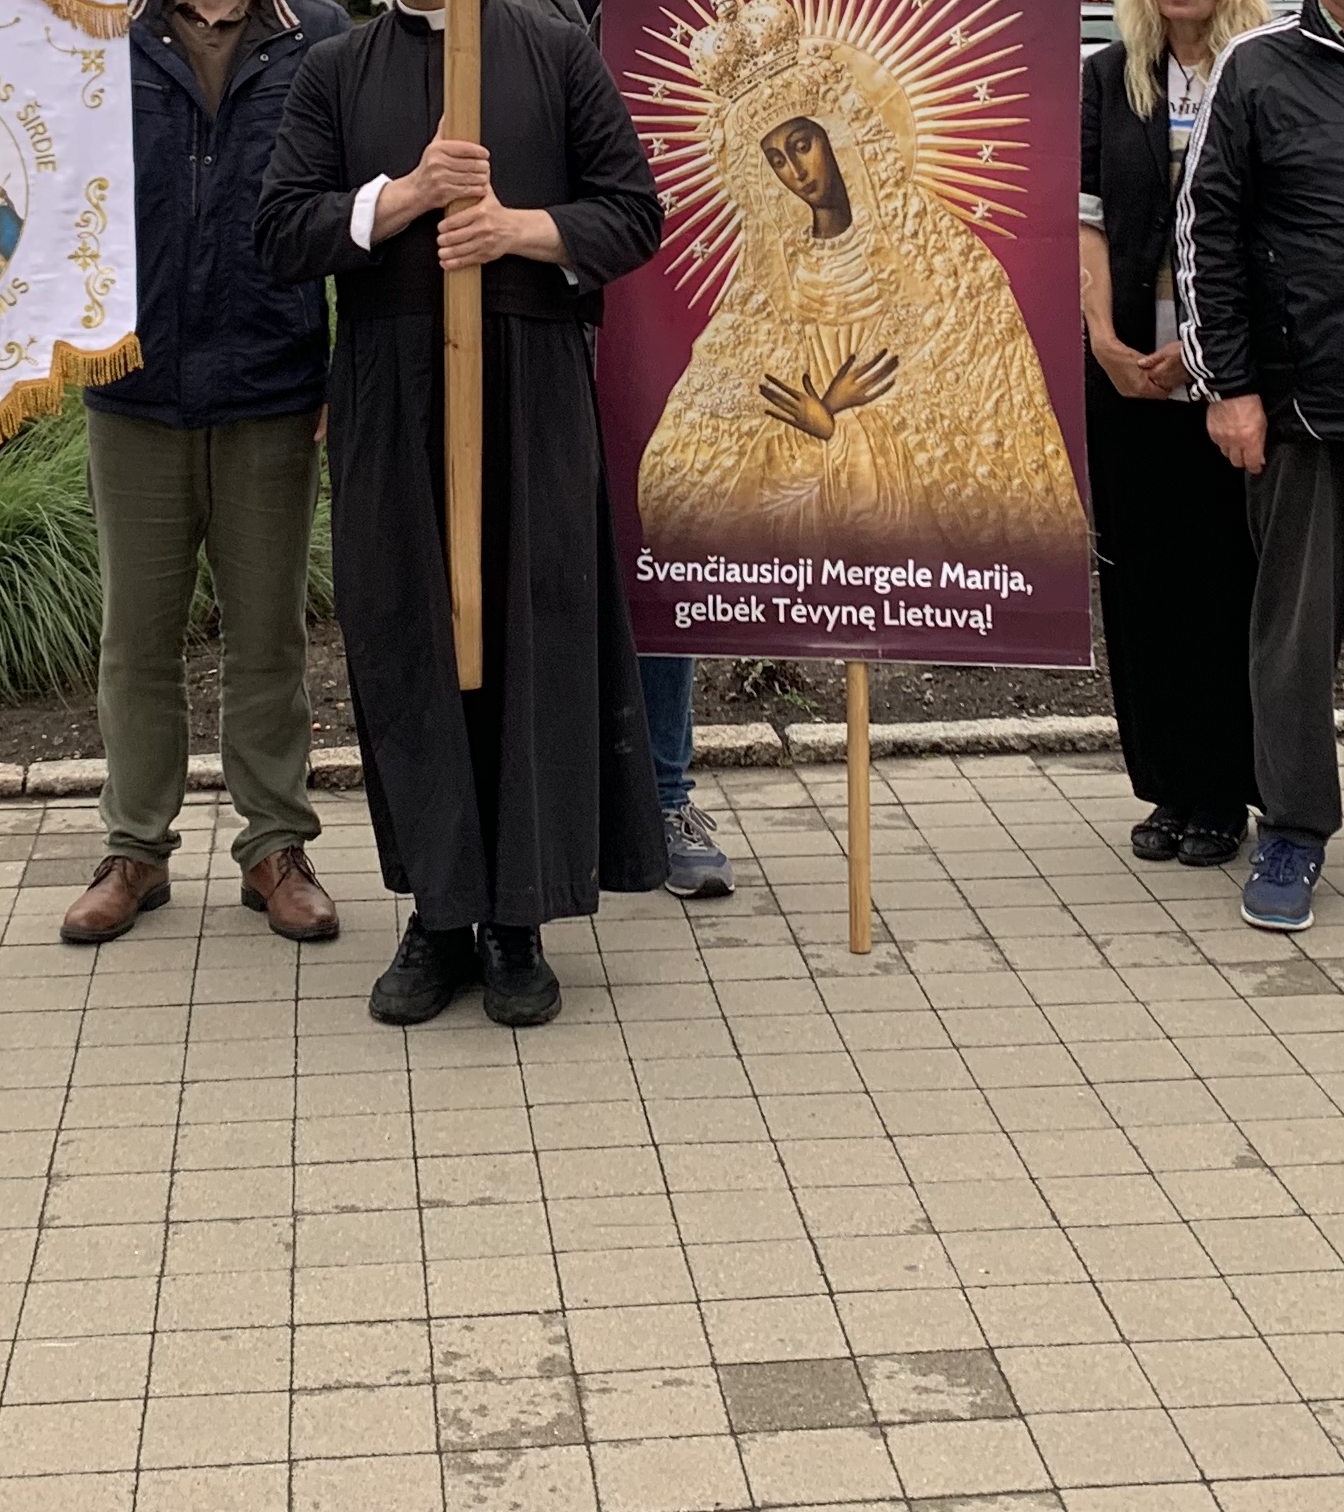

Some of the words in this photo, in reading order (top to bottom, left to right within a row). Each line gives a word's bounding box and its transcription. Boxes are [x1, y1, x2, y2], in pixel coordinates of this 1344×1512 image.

[16, 98, 57, 173] ŠIRDIE
[635, 548, 814, 591] Švenčiausioji
[821, 559, 932, 594] Mergele
[939, 561, 1033, 599] Marija,
[674, 593, 766, 629] gelbėk
[772, 598, 875, 632] Tėvynę
[883, 599, 993, 636] Lietuvą!
